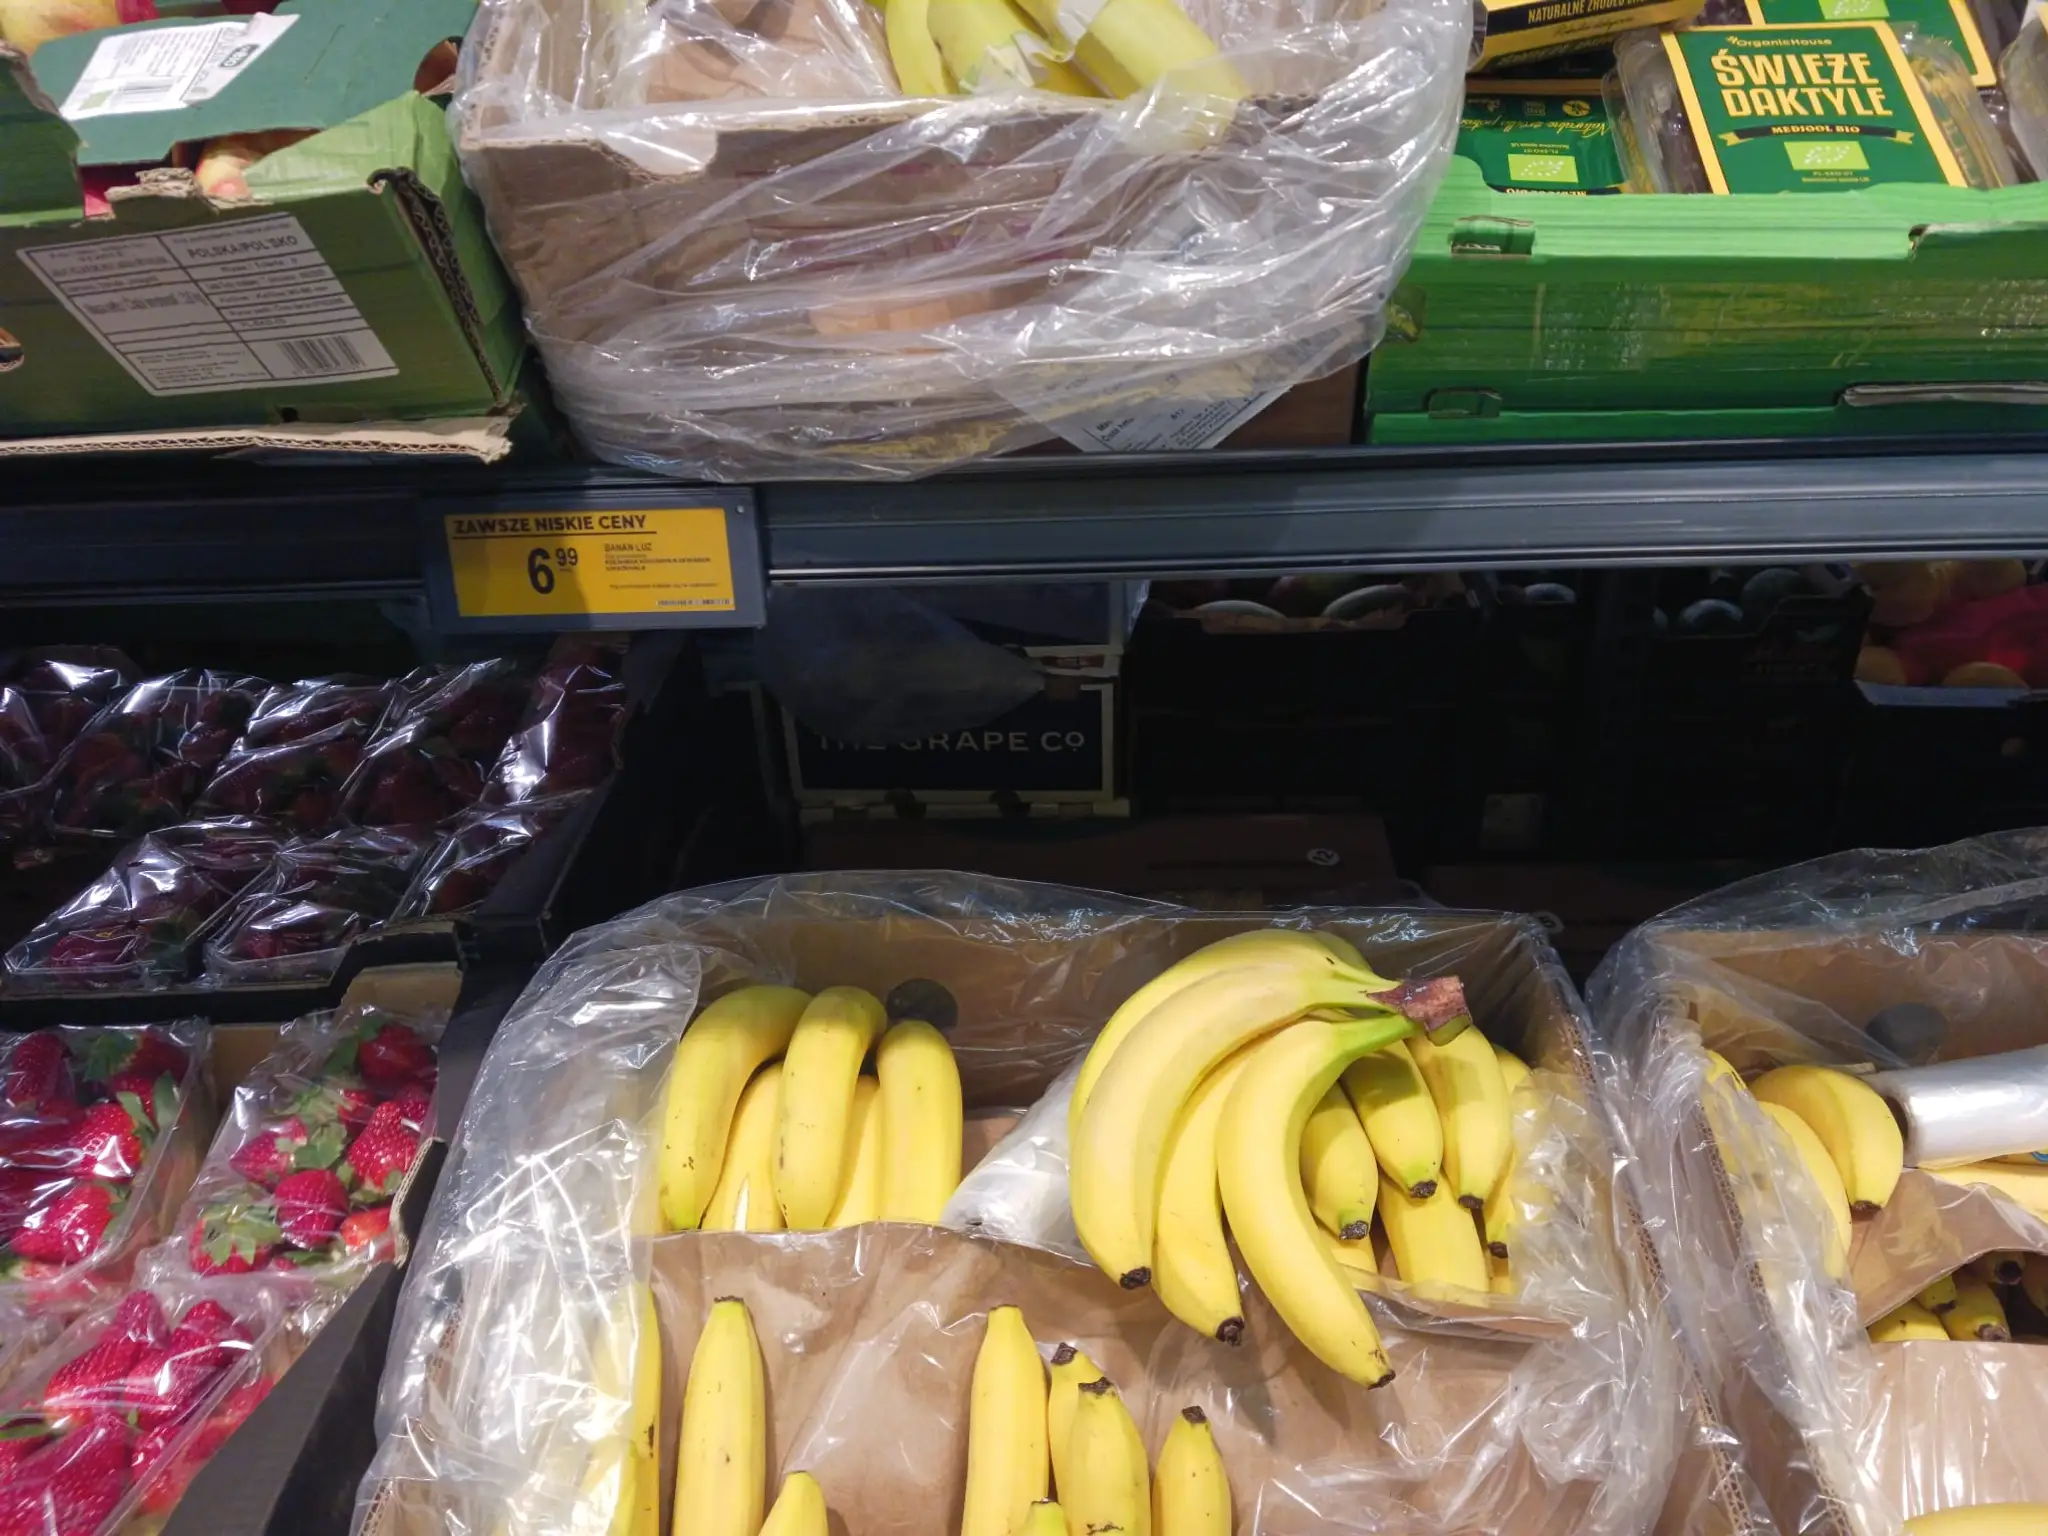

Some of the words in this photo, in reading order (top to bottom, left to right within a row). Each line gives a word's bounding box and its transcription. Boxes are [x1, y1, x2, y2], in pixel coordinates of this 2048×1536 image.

[1528, 0, 1585, 24] NATURALNE
[1711, 48, 1880, 86] ŚWIEŻE
[1720, 87, 1894, 117] DAKTYLE
[1835, 124, 1861, 134] BIO
[452, 517, 531, 535] ZAWSZE
[534, 515, 595, 531] NISKIE
[598, 514, 647, 530] CENY
[527, 547, 555, 595] 6
[556, 547, 579, 567] 99
